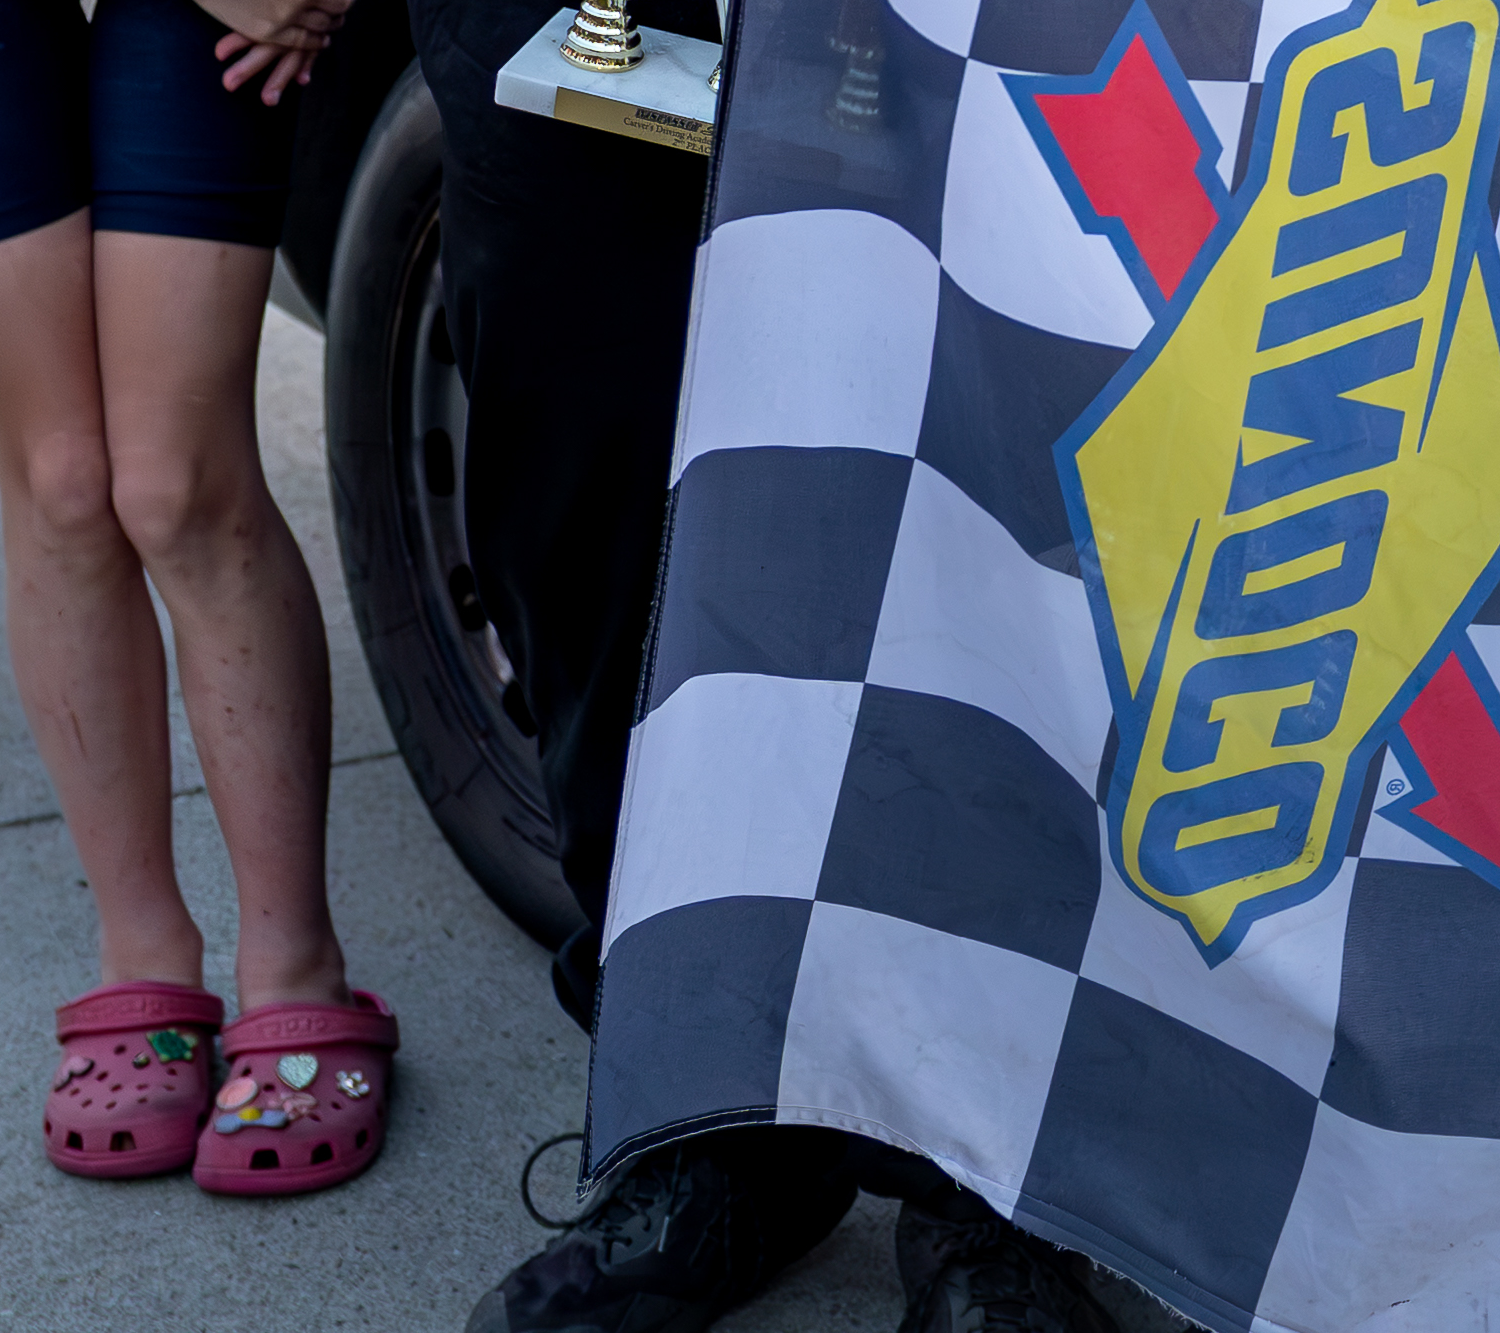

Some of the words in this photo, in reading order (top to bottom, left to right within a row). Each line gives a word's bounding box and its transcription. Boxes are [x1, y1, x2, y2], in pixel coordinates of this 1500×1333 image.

[623, 117, 655, 133] Carver's
[655, 124, 685, 140] Driving
[686, 132, 715, 146] Acade
[685, 141, 714, 154] PLAC
